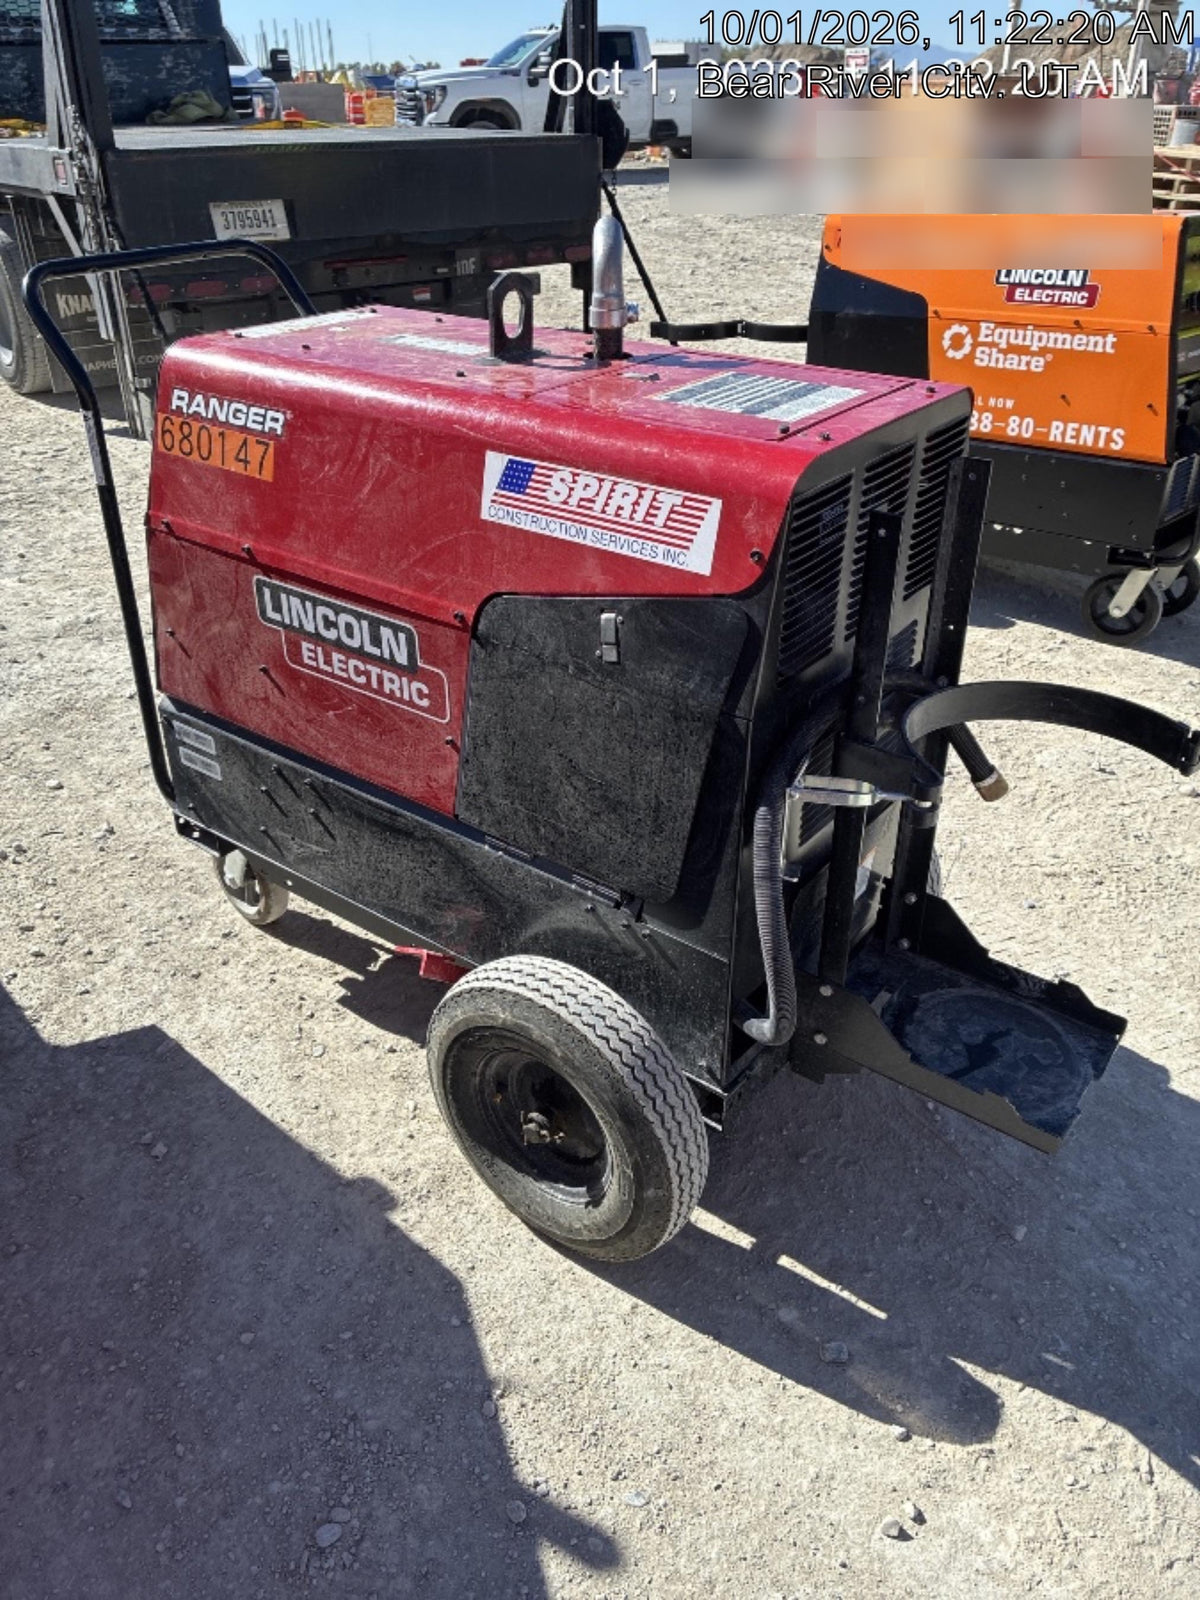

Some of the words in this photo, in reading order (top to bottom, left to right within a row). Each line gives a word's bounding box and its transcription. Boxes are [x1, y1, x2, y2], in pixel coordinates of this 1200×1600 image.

[221, 208, 277, 231] 3795941
[999, 269, 1084, 287] LINCOLN
[1014, 289, 1089, 305] ELECTRIC
[978, 322, 1117, 354] Equipment
[171, 388, 286, 436] RANGER
[988, 397, 1015, 410] NOW
[161, 416, 271, 477] 680147
[545, 469, 684, 528] SPIRIT
[488, 504, 588, 542] CONSTRUCTION
[590, 529, 659, 560] SERVICES
[662, 550, 689, 568] INC.
[262, 586, 409, 666] LINCOLN
[301, 641, 431, 708] ELECTRIC
